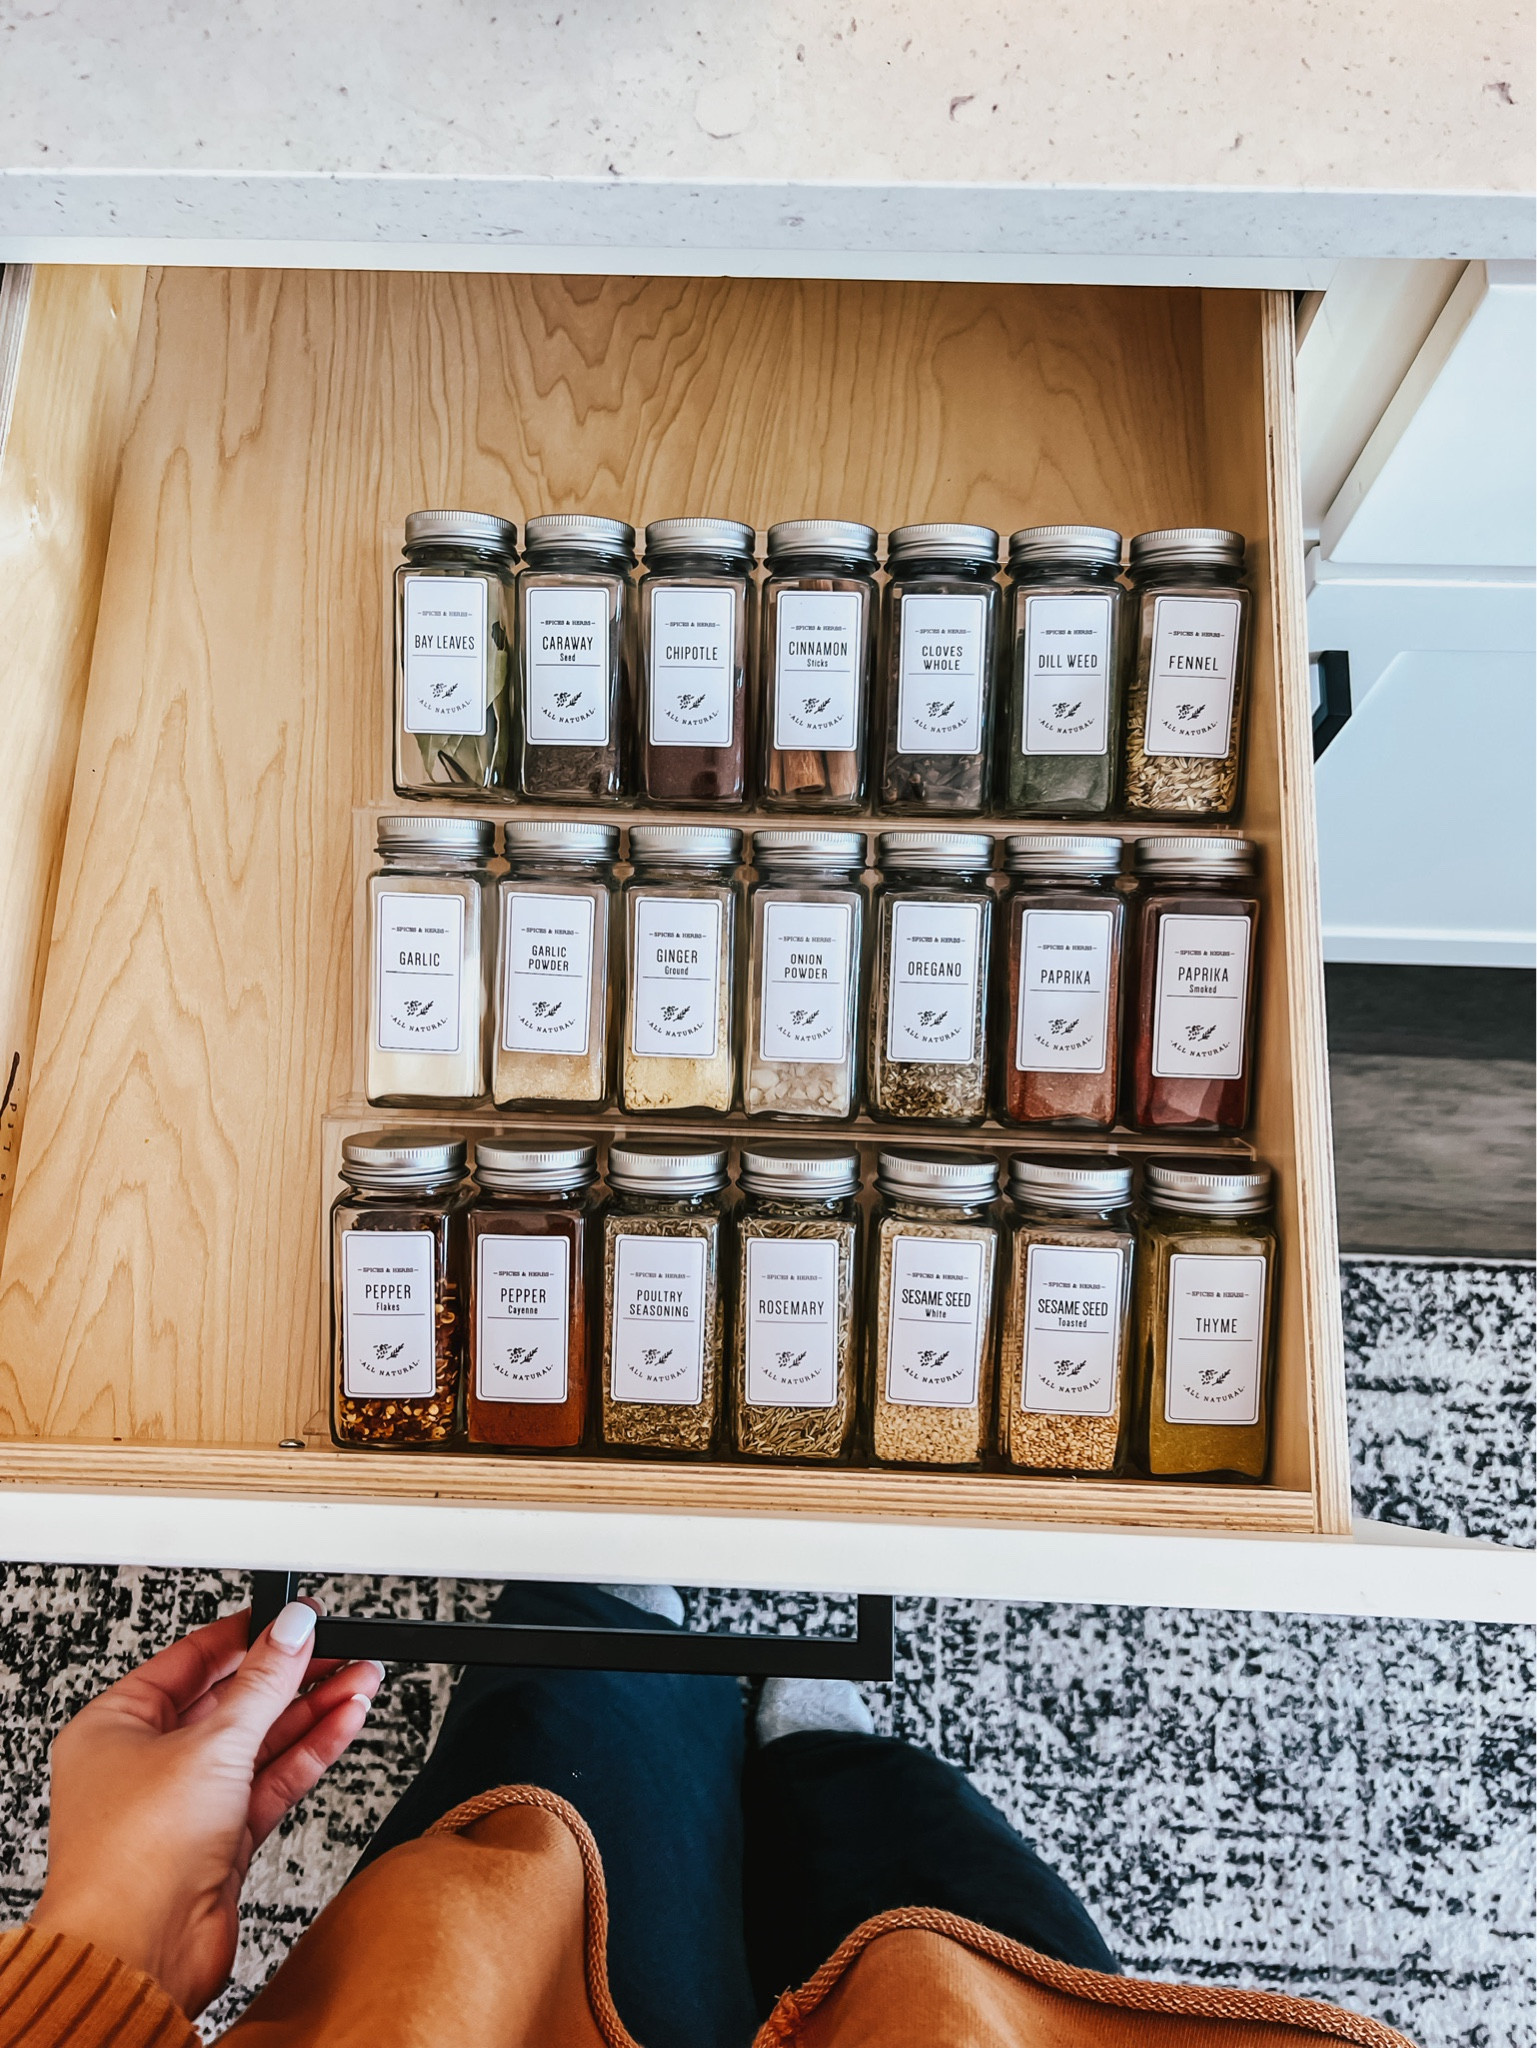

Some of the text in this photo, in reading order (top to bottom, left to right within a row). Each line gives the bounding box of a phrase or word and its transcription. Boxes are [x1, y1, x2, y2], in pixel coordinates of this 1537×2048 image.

[414, 634, 475, 650] BAY LEAVES
[542, 636, 593, 651] CARAWAY
[788, 641, 848, 657] CINNAMON
[560, 653, 576, 662] Seed
[666, 646, 718, 661] CHIPOTLE
[921, 646, 963, 657] CLOVES
[807, 659, 828, 668] Sticks
[923, 659, 960, 671] WHOLE
[1038, 654, 1098, 669] DILL WEED
[1168, 655, 1219, 671] FENNEL
[532, 945, 567, 958] GARLIC
[656, 949, 698, 964] GINGER
[790, 953, 823, 965] ONION
[399, 952, 440, 967] GARLIC
[528, 958, 569, 972] POWDER
[664, 966, 688, 975] Ground
[784, 967, 828, 979] POWDER
[908, 961, 962, 977] OREGANO
[1178, 966, 1229, 982] PAPRIKA
[1040, 969, 1091, 985] PAPRIKA
[1189, 984, 1217, 994] Smoked
[365, 1284, 411, 1299] PEPPER
[501, 1288, 546, 1303] PEPPER
[637, 1289, 683, 1303] POULTRY
[902, 1289, 971, 1308] SESAME SEED
[376, 1302, 400, 1311] Flakes
[508, 1305, 538, 1316] Cayenne
[629, 1304, 689, 1317] SEASONING
[759, 1299, 825, 1316] ROSEMARY
[925, 1309, 947, 1318] White
[1038, 1298, 1108, 1317] SESAME SEED
[1058, 1317, 1087, 1328] Toasted
[1196, 1317, 1238, 1334] THYME
